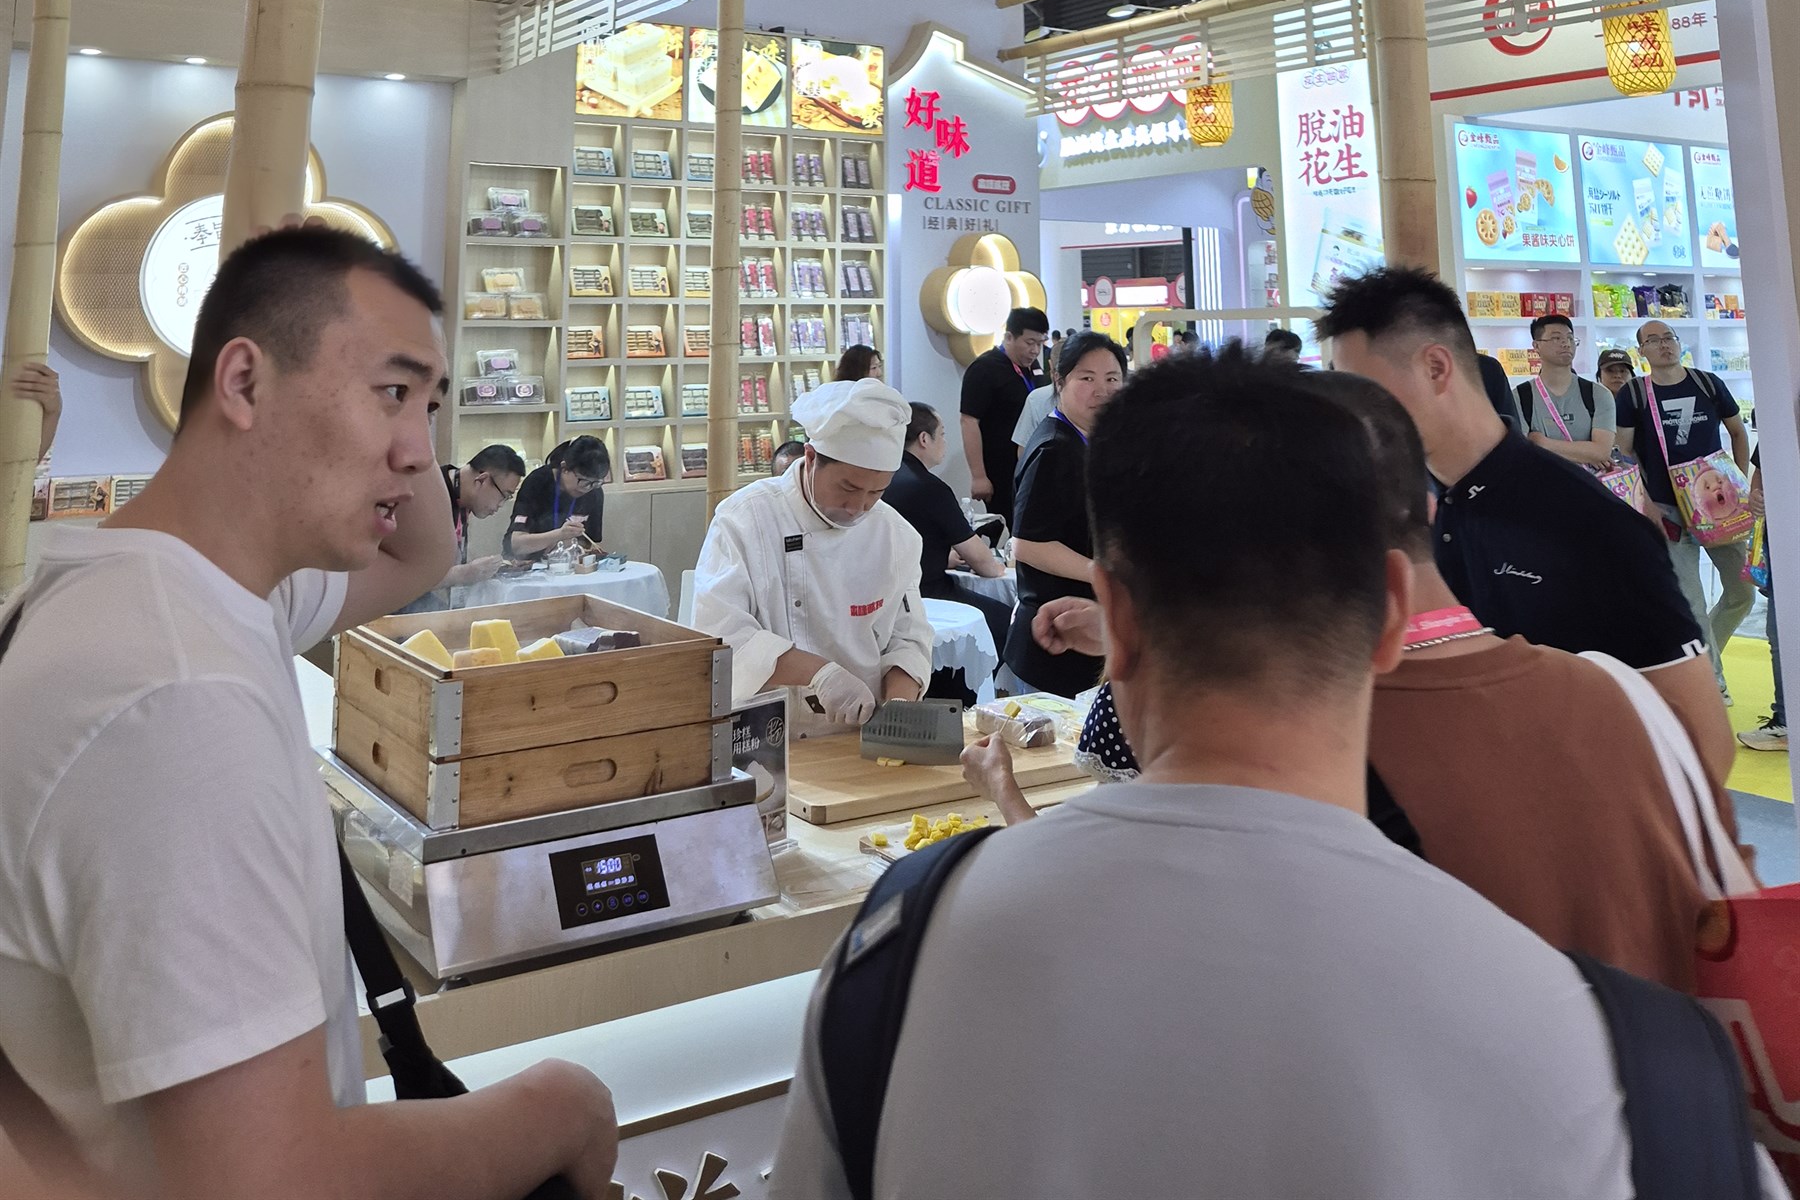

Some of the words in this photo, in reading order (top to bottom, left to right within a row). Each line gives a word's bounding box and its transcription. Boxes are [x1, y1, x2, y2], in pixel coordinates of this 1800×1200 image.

[903, 86, 972, 194] 好味道
[1297, 104, 1365, 148] 脱油
[1298, 143, 1369, 188] 花生
[924, 196, 990, 213] CLASSIC
[996, 197, 1032, 215] GIFT
[1661, 396, 1696, 446] 7
[595, 856, 623, 875] 1500
